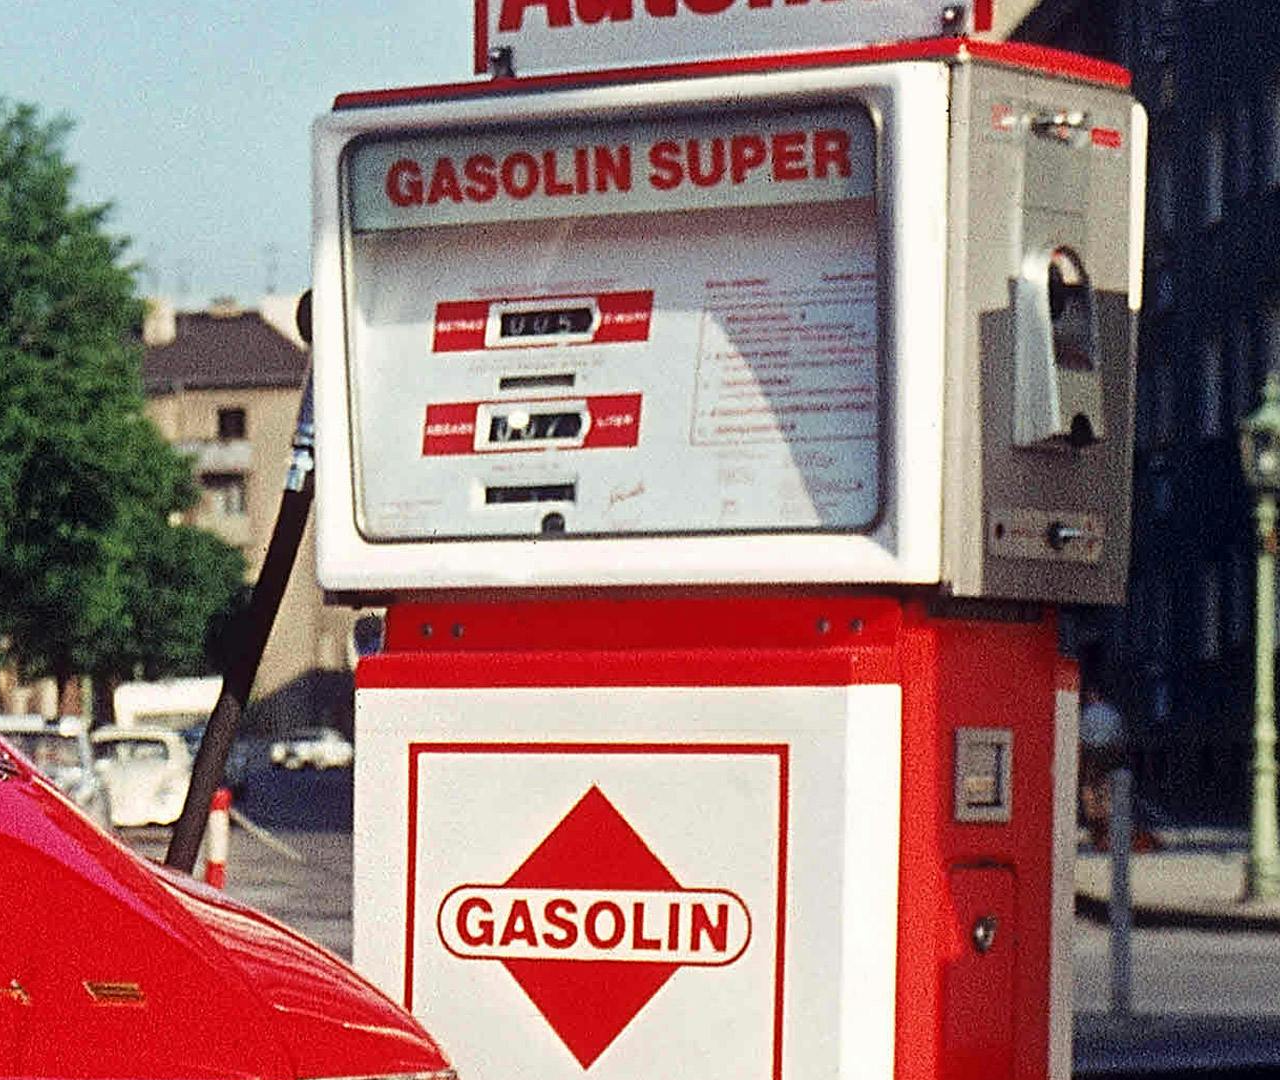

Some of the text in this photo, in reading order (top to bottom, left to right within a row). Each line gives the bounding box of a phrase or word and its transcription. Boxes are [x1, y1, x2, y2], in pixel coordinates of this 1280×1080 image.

[384, 128, 853, 208] GASOLIN SUPER
[455, 896, 730, 952] GASOLIN
